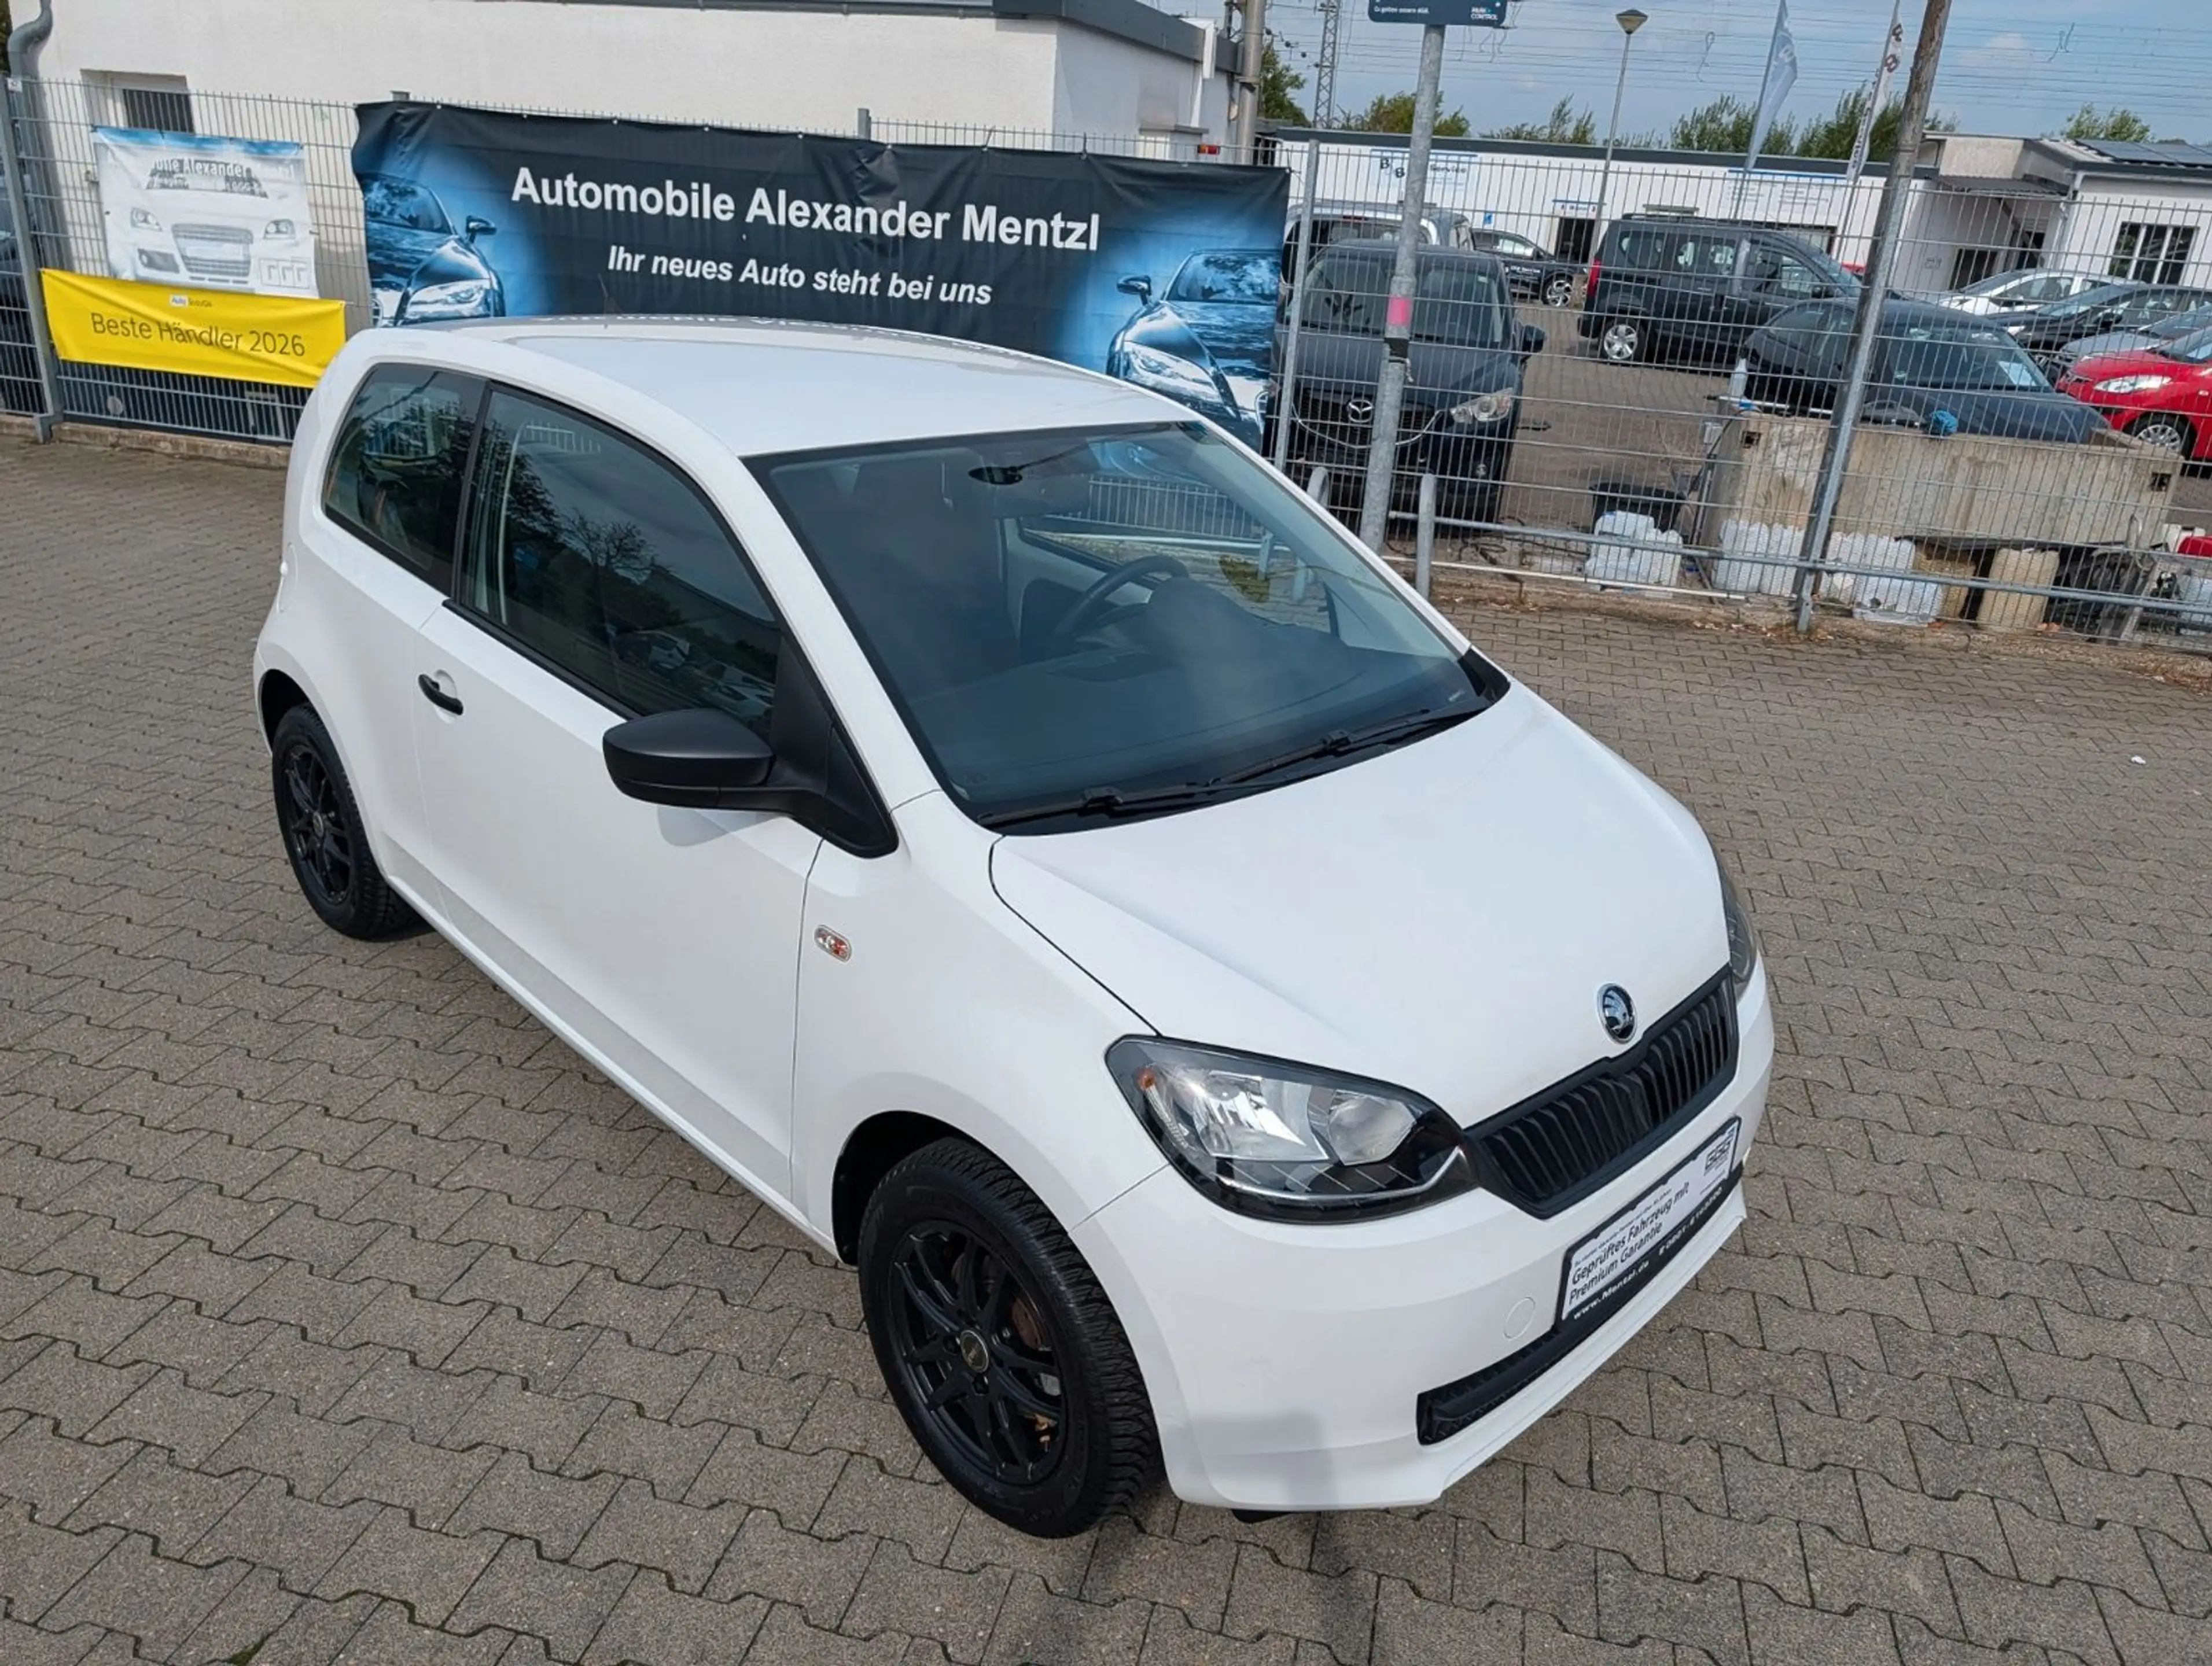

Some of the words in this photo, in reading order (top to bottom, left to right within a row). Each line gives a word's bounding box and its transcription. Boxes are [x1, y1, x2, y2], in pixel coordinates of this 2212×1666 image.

[511, 166, 736, 222] Automobile
[745, 187, 951, 240] Alexander
[962, 204, 1101, 252] Mentzl
[608, 245, 646, 272] Ihr
[651, 255, 734, 282] neues
[738, 258, 806, 289] Auto
[812, 268, 882, 297] steht
[887, 272, 934, 301] bei
[938, 282, 993, 305] uns
[91, 312, 152, 340] Beste
[157, 322, 243, 351] Händler
[248, 330, 306, 357] 2026
[1627, 1197, 1673, 1244] Fahrzeug
[1673, 1182, 1690, 1207] mit
[1569, 1259, 1618, 1306] Premium
